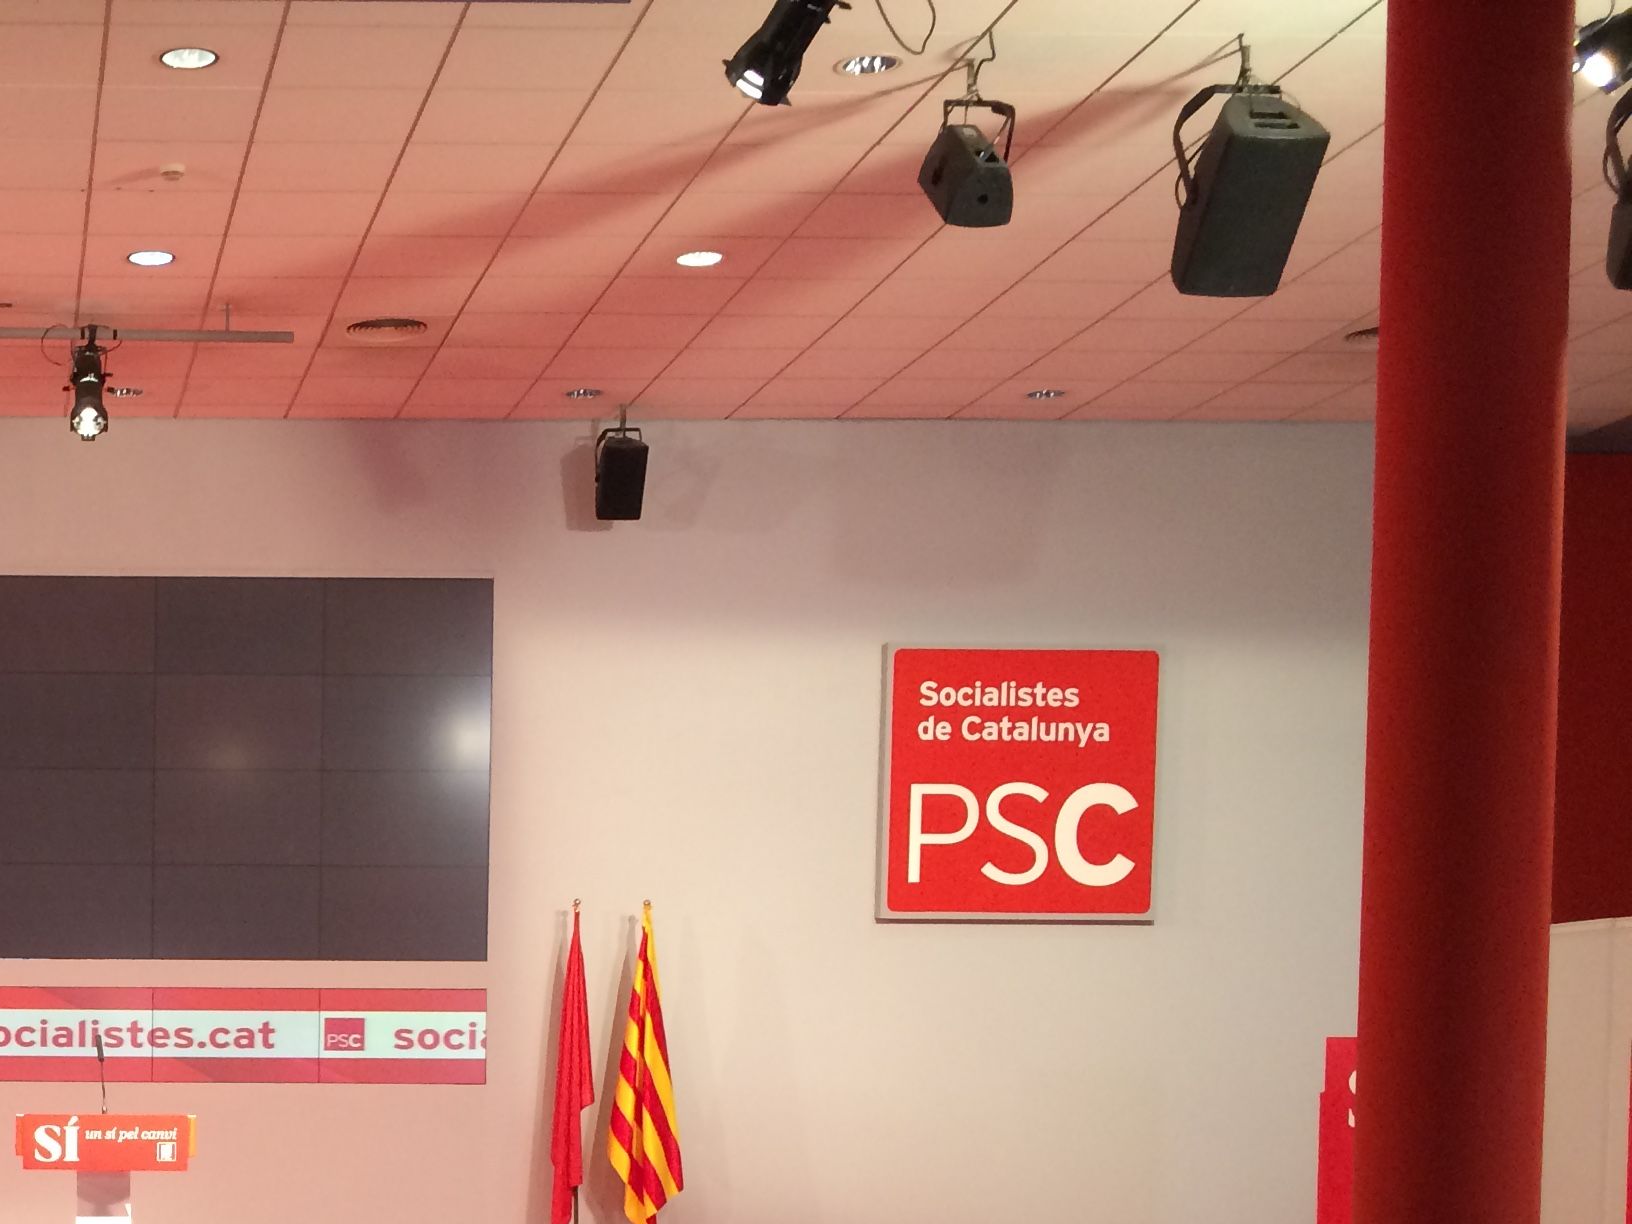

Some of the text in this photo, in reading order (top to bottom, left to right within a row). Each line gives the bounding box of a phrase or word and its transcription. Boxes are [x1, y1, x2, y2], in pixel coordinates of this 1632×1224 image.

[919, 680, 1080, 707] Socialistes
[917, 715, 1111, 748] de Catalunya
[907, 781, 1139, 887] PSC
[326, 1033, 362, 1048] PSC
[33, 1115, 80, 1163] SÍ
[85, 1129, 102, 1140] un
[117, 1127, 138, 1143] pel
[141, 1128, 177, 1140] canvi
